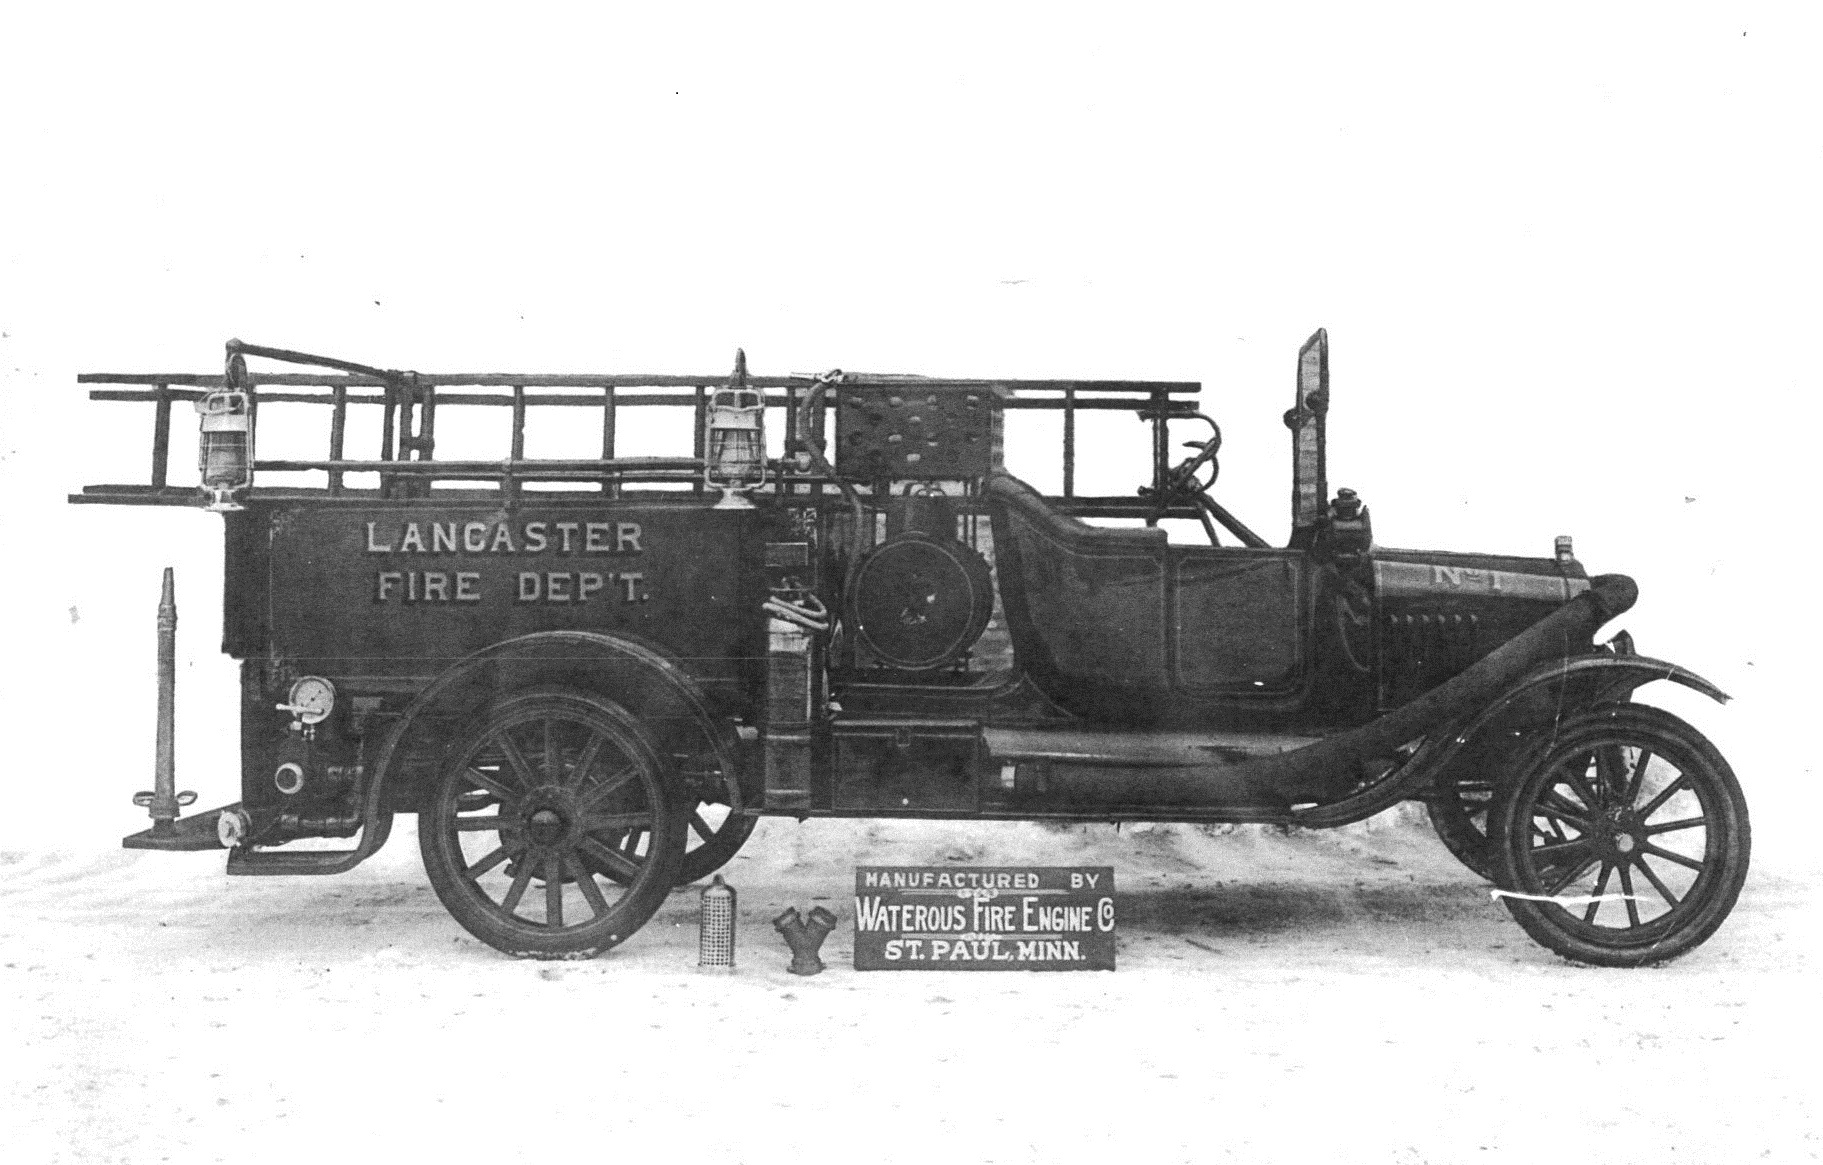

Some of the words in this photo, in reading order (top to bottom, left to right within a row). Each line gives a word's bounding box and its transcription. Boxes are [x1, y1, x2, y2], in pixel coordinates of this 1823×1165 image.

[367, 521, 643, 551] LANCASTER
[379, 571, 480, 601] FIRE
[865, 872, 1040, 888] MANUFACTURED
[1070, 873, 1099, 889] BY
[855, 896, 967, 932] WATEROUS
[973, 897, 1016, 931] FIRE
[1022, 897, 1092, 932] ENGINE
[884, 940, 925, 961] ST.
[931, 940, 1014, 962] PAUL,
[1016, 941, 1087, 961] MINN.
